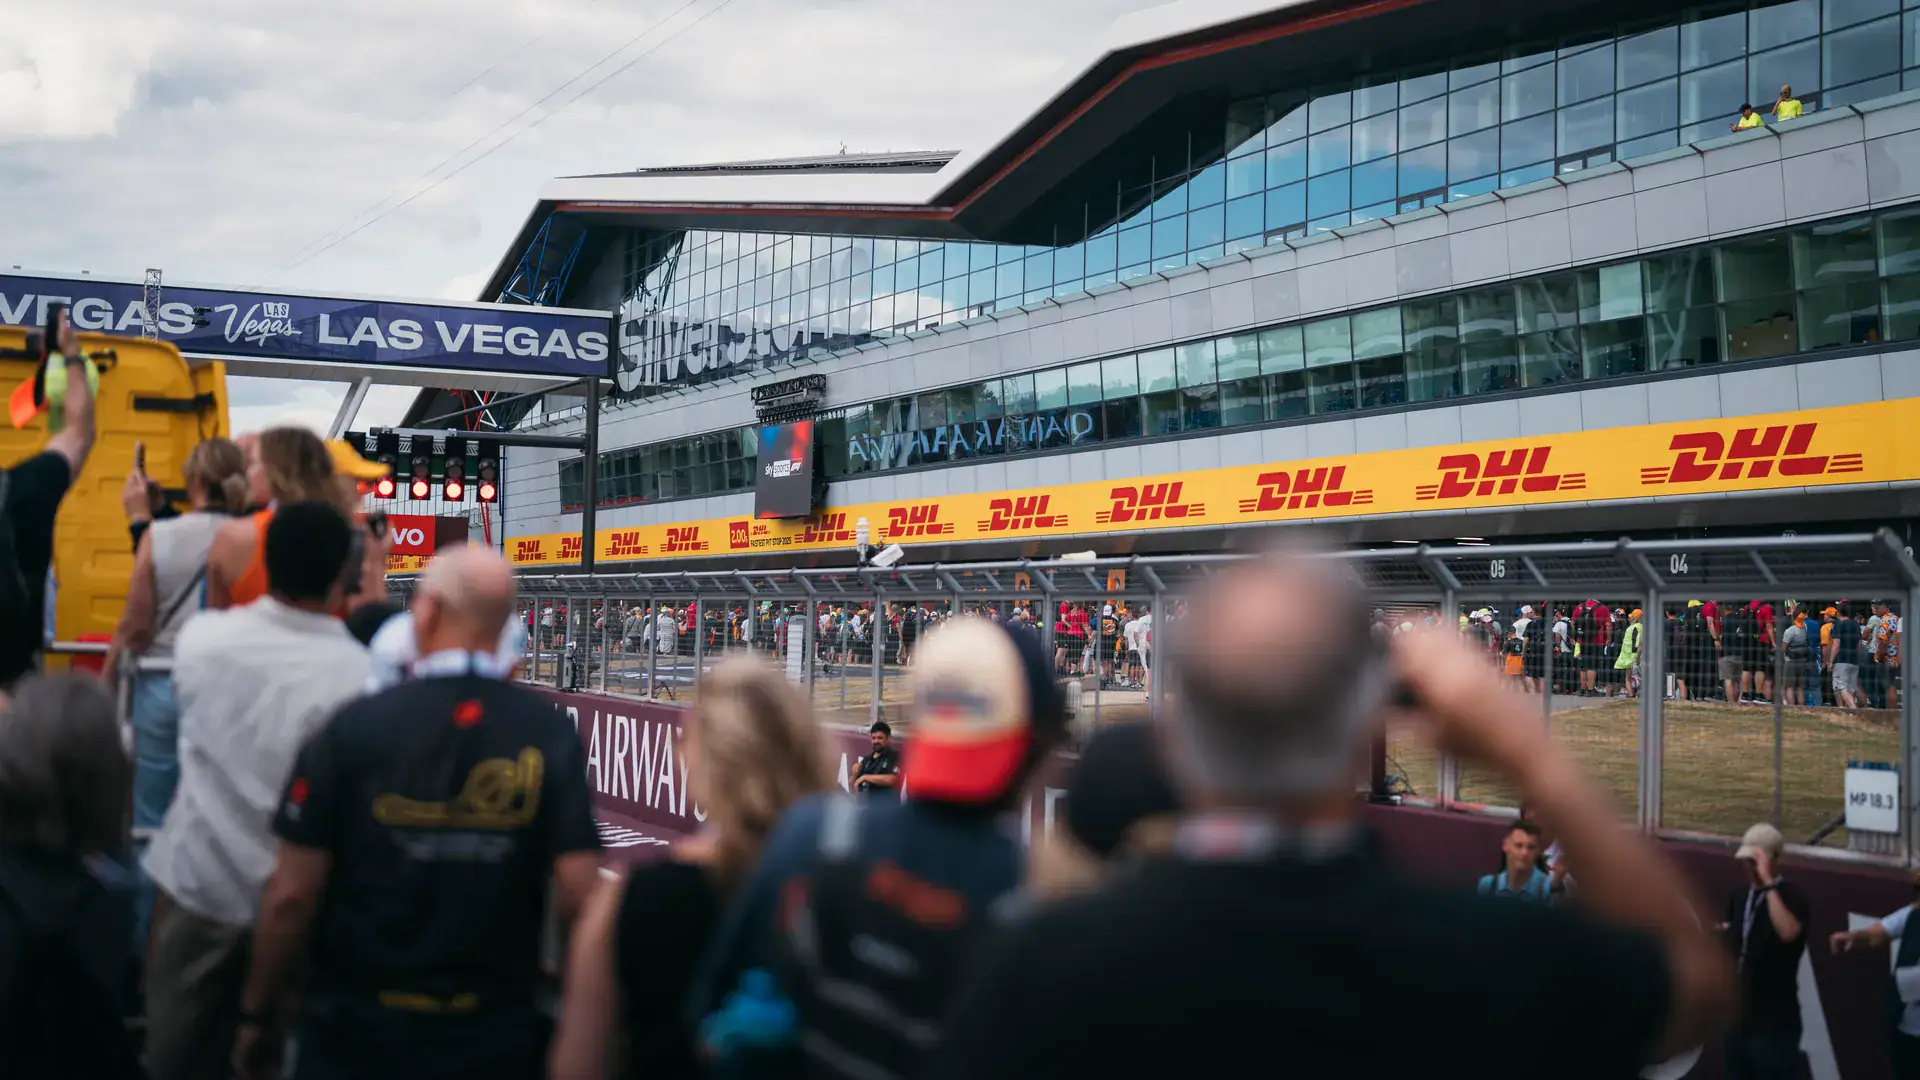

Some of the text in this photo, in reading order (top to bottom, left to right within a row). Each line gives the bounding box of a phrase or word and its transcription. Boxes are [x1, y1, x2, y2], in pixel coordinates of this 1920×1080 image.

[264, 303, 288, 317] LAS
[215, 304, 302, 347] Vegas
[319, 313, 609, 362] LAS VEGAS
[1668, 423, 1829, 483] DHL
[1437, 446, 1560, 499] DHL
[1109, 481, 1189, 523] DHL
[1256, 465, 1353, 512] DHL
[888, 504, 943, 537] DHL
[989, 495, 1054, 531] DHL
[666, 526, 702, 552] DHL
[753, 525, 769, 535] DHL
[772, 537, 782, 545] STOP
[802, 513, 849, 542] DHL
[517, 540, 542, 561] DHL
[561, 537, 583, 558] DH
[611, 531, 642, 556] DHL
[1490, 559, 1506, 578] 05
[1670, 553, 1688, 574] 04
[584, 710, 708, 822] AIRWAY
[1849, 791, 1895, 810] MP 18.3
